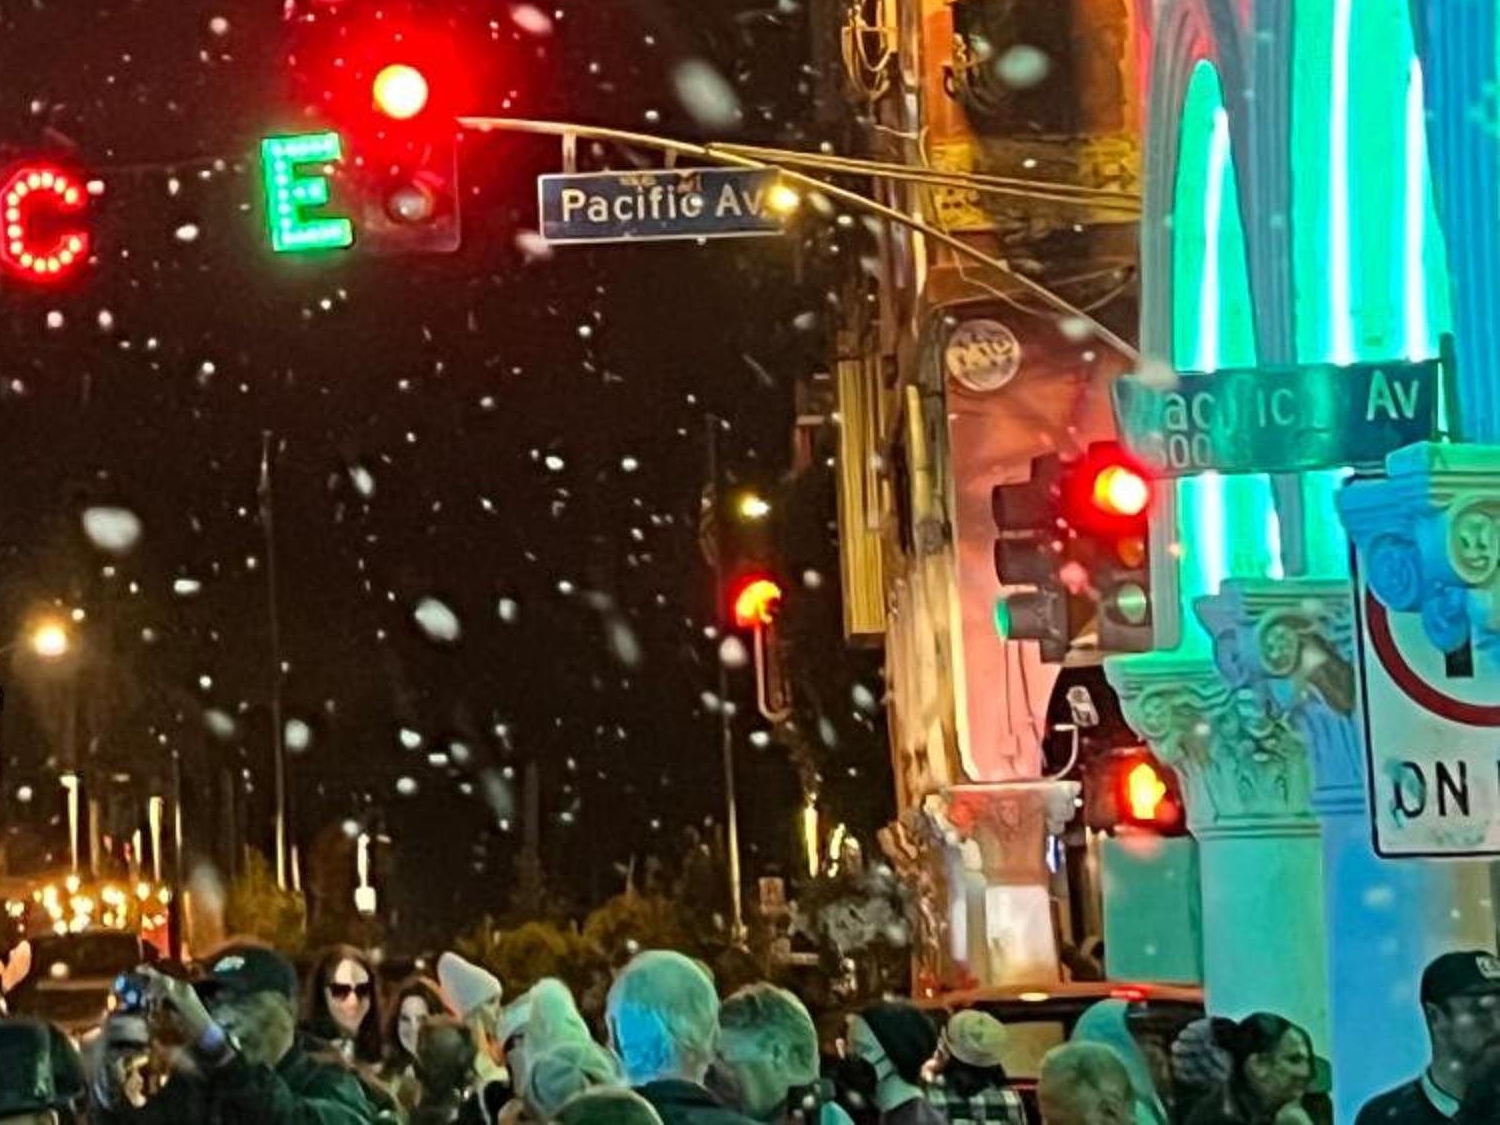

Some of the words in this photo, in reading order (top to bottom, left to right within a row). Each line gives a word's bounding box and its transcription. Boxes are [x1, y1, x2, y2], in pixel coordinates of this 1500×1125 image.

[560, 184, 702, 223] Pacific
[1138, 377, 1296, 432] acic
[1365, 369, 1420, 421] Av
[1393, 759, 1471, 818] ON
